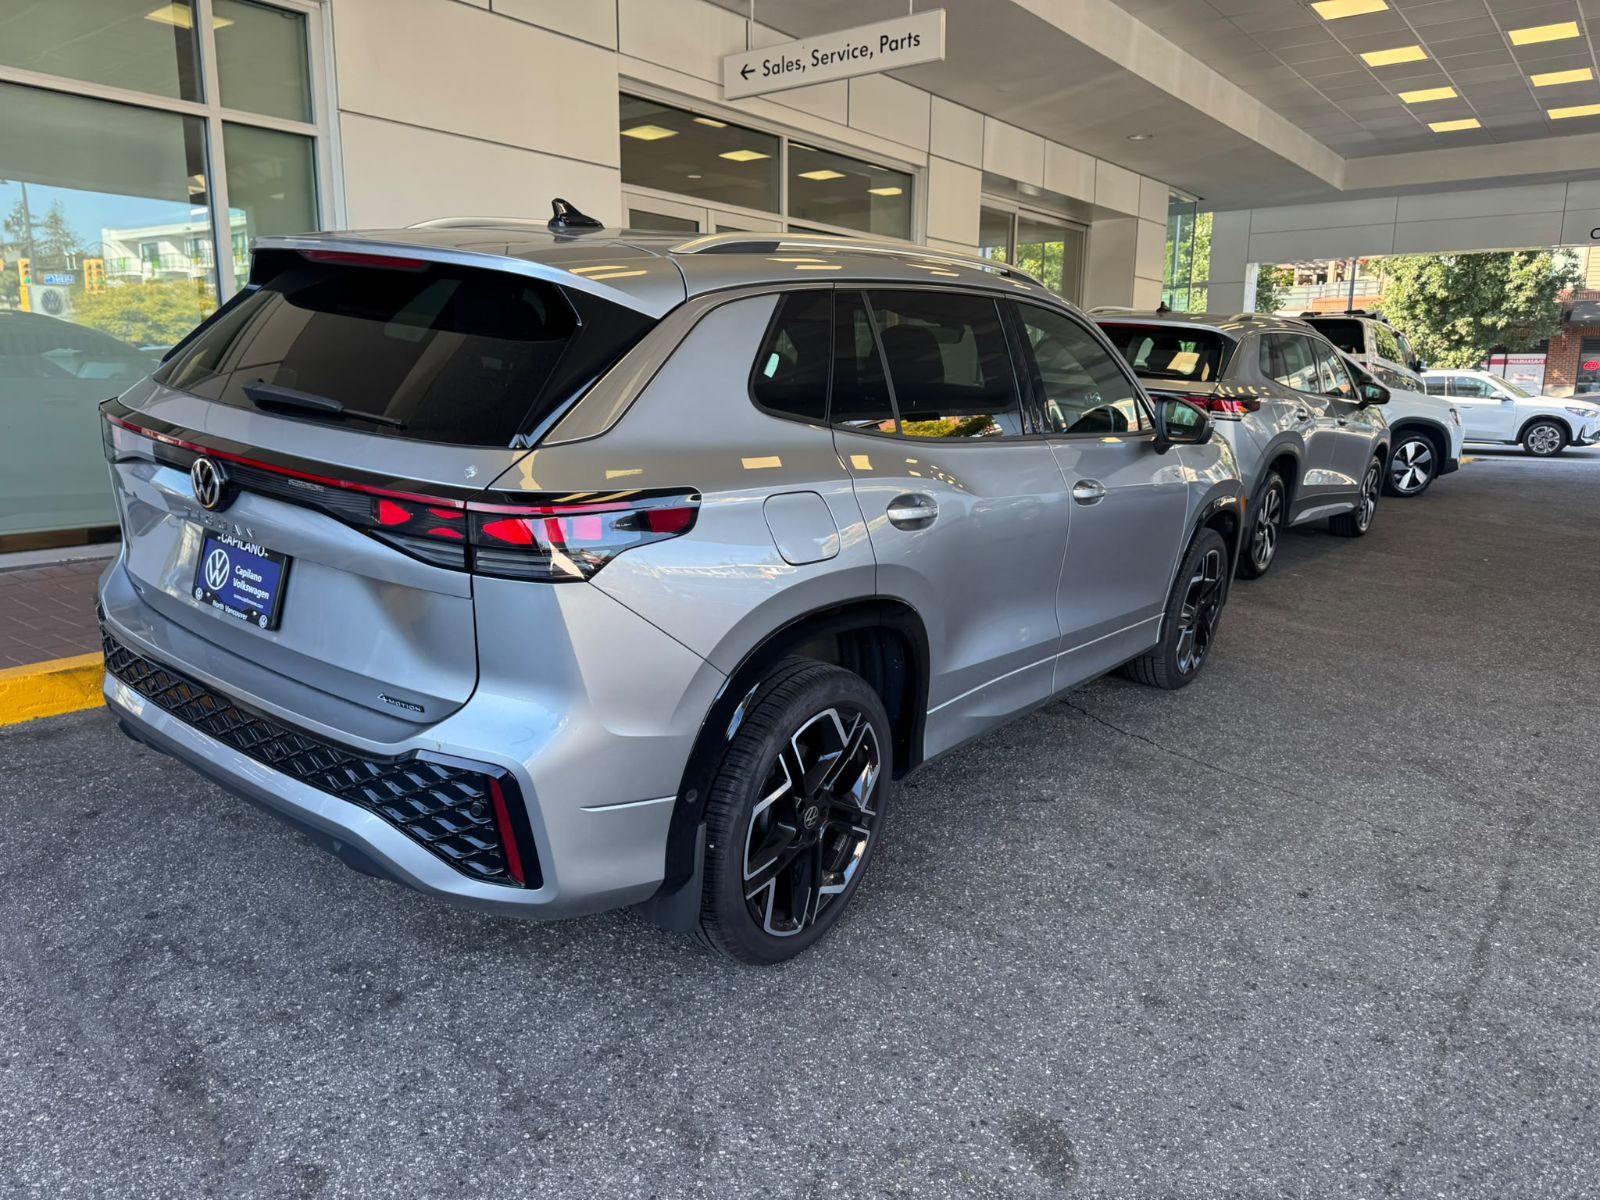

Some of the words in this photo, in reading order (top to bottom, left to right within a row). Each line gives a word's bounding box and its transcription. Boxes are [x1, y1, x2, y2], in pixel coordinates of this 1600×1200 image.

[763, 55, 806, 77] Sales,
[811, 43, 874, 68] Service,
[879, 32, 921, 54] Parts
[221, 533, 266, 558] CAPILANO
[235, 565, 263, 583] Capilano
[232, 577, 271, 600] Volkswagen
[212, 600, 225, 610] North
[225, 604, 249, 620] Vancouver
